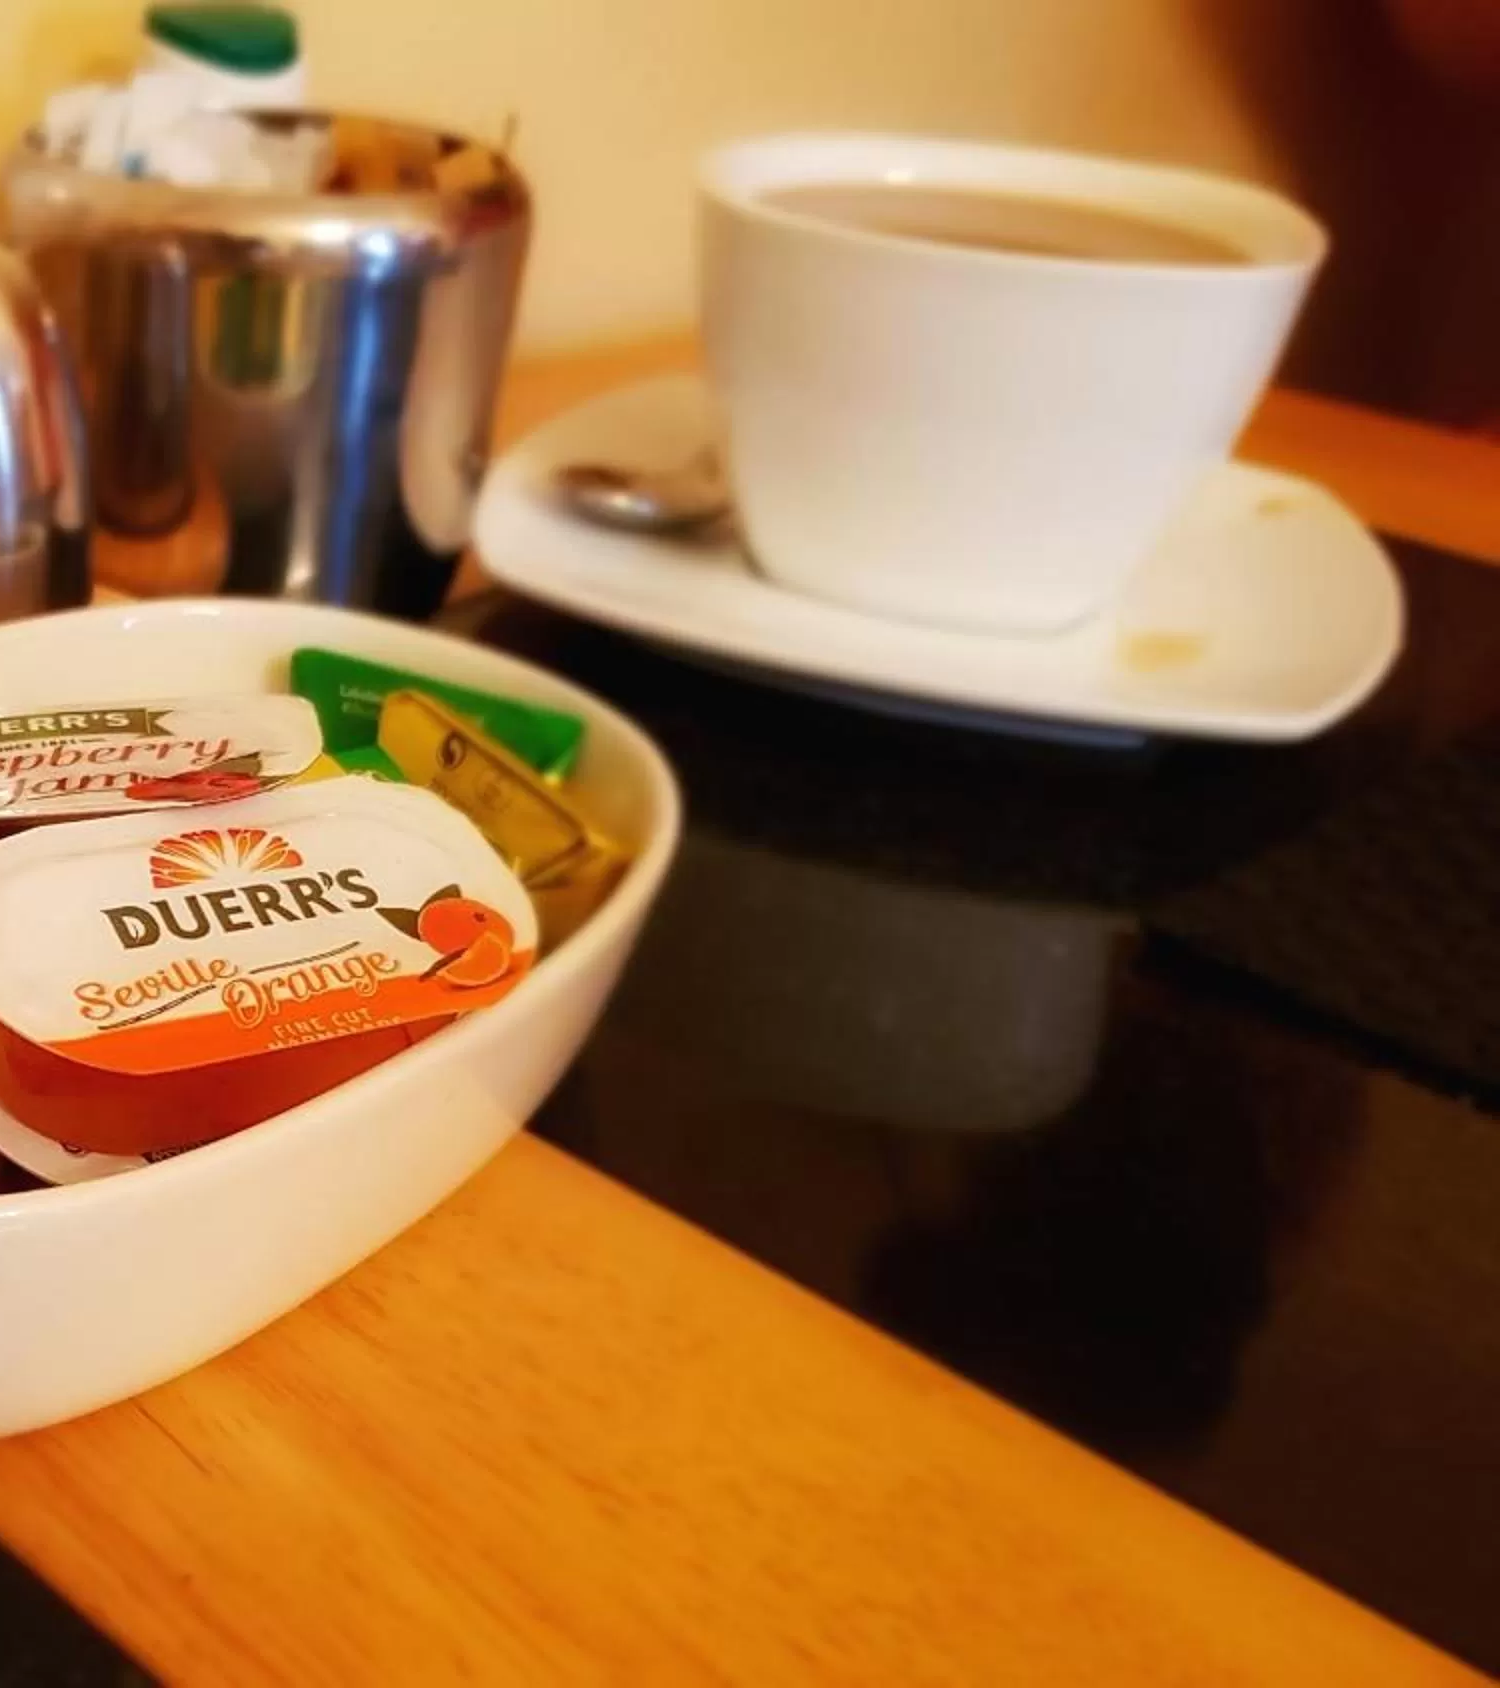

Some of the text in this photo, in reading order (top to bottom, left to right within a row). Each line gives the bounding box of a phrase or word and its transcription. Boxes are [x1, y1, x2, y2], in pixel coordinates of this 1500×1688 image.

[100, 868, 380, 950] DUERR'S
[73, 952, 240, 1021] Seville
[220, 948, 401, 1031] Orange
[273, 1007, 373, 1040] FINE CUT
